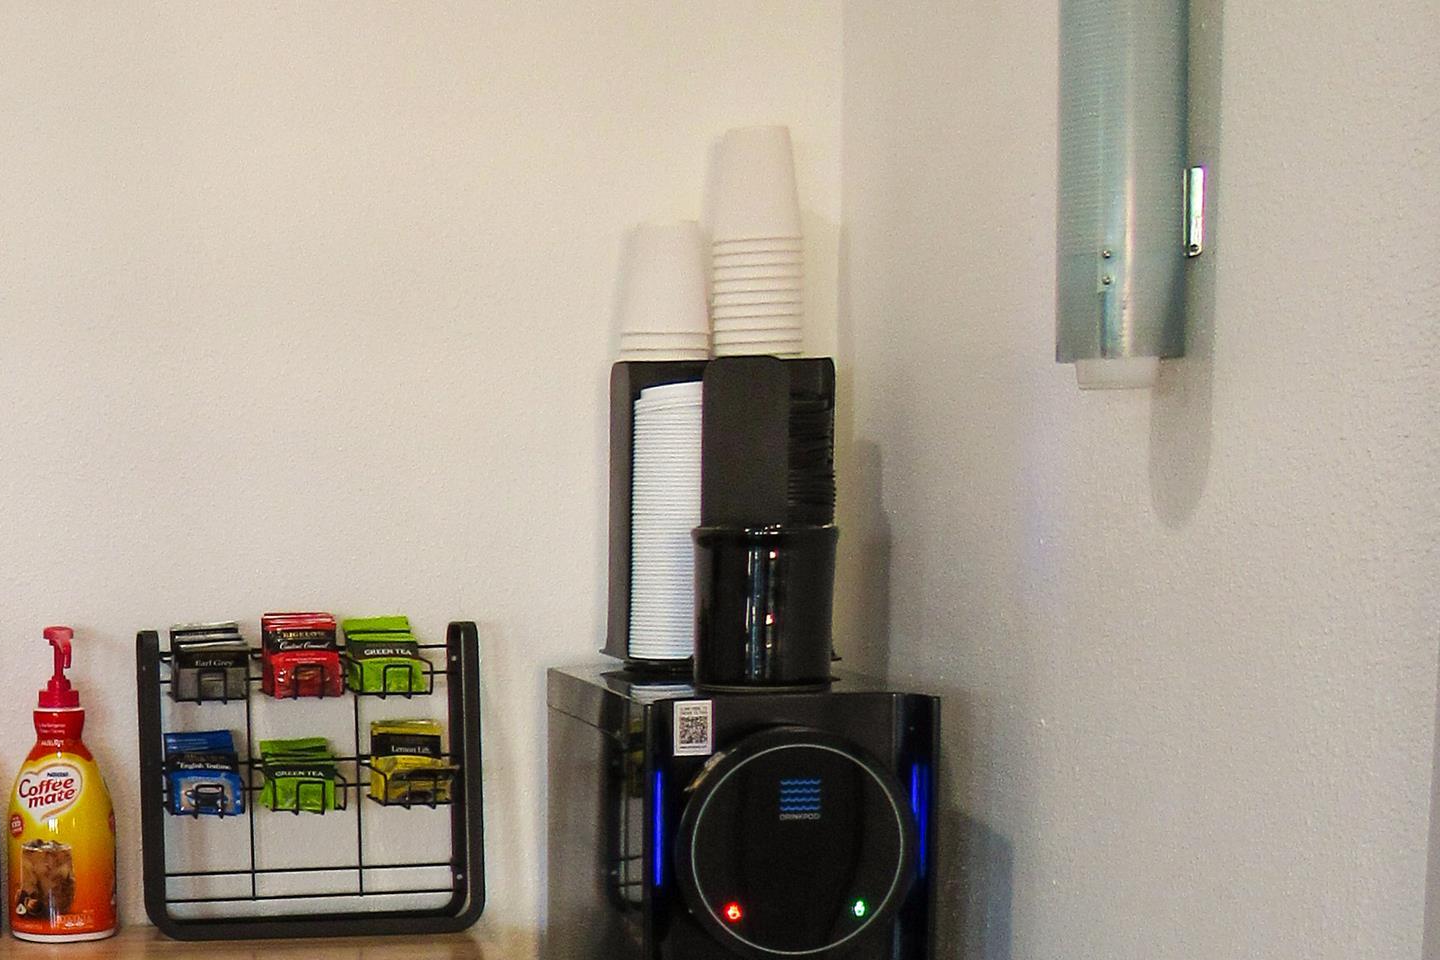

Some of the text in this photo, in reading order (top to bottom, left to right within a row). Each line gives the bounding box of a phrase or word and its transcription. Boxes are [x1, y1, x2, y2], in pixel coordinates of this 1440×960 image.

[363, 648, 412, 656] GREEN TEA
[213, 660, 233, 668] Grey
[180, 762, 204, 770] English
[18, 778, 74, 798] Coffee
[29, 789, 75, 808] mate
